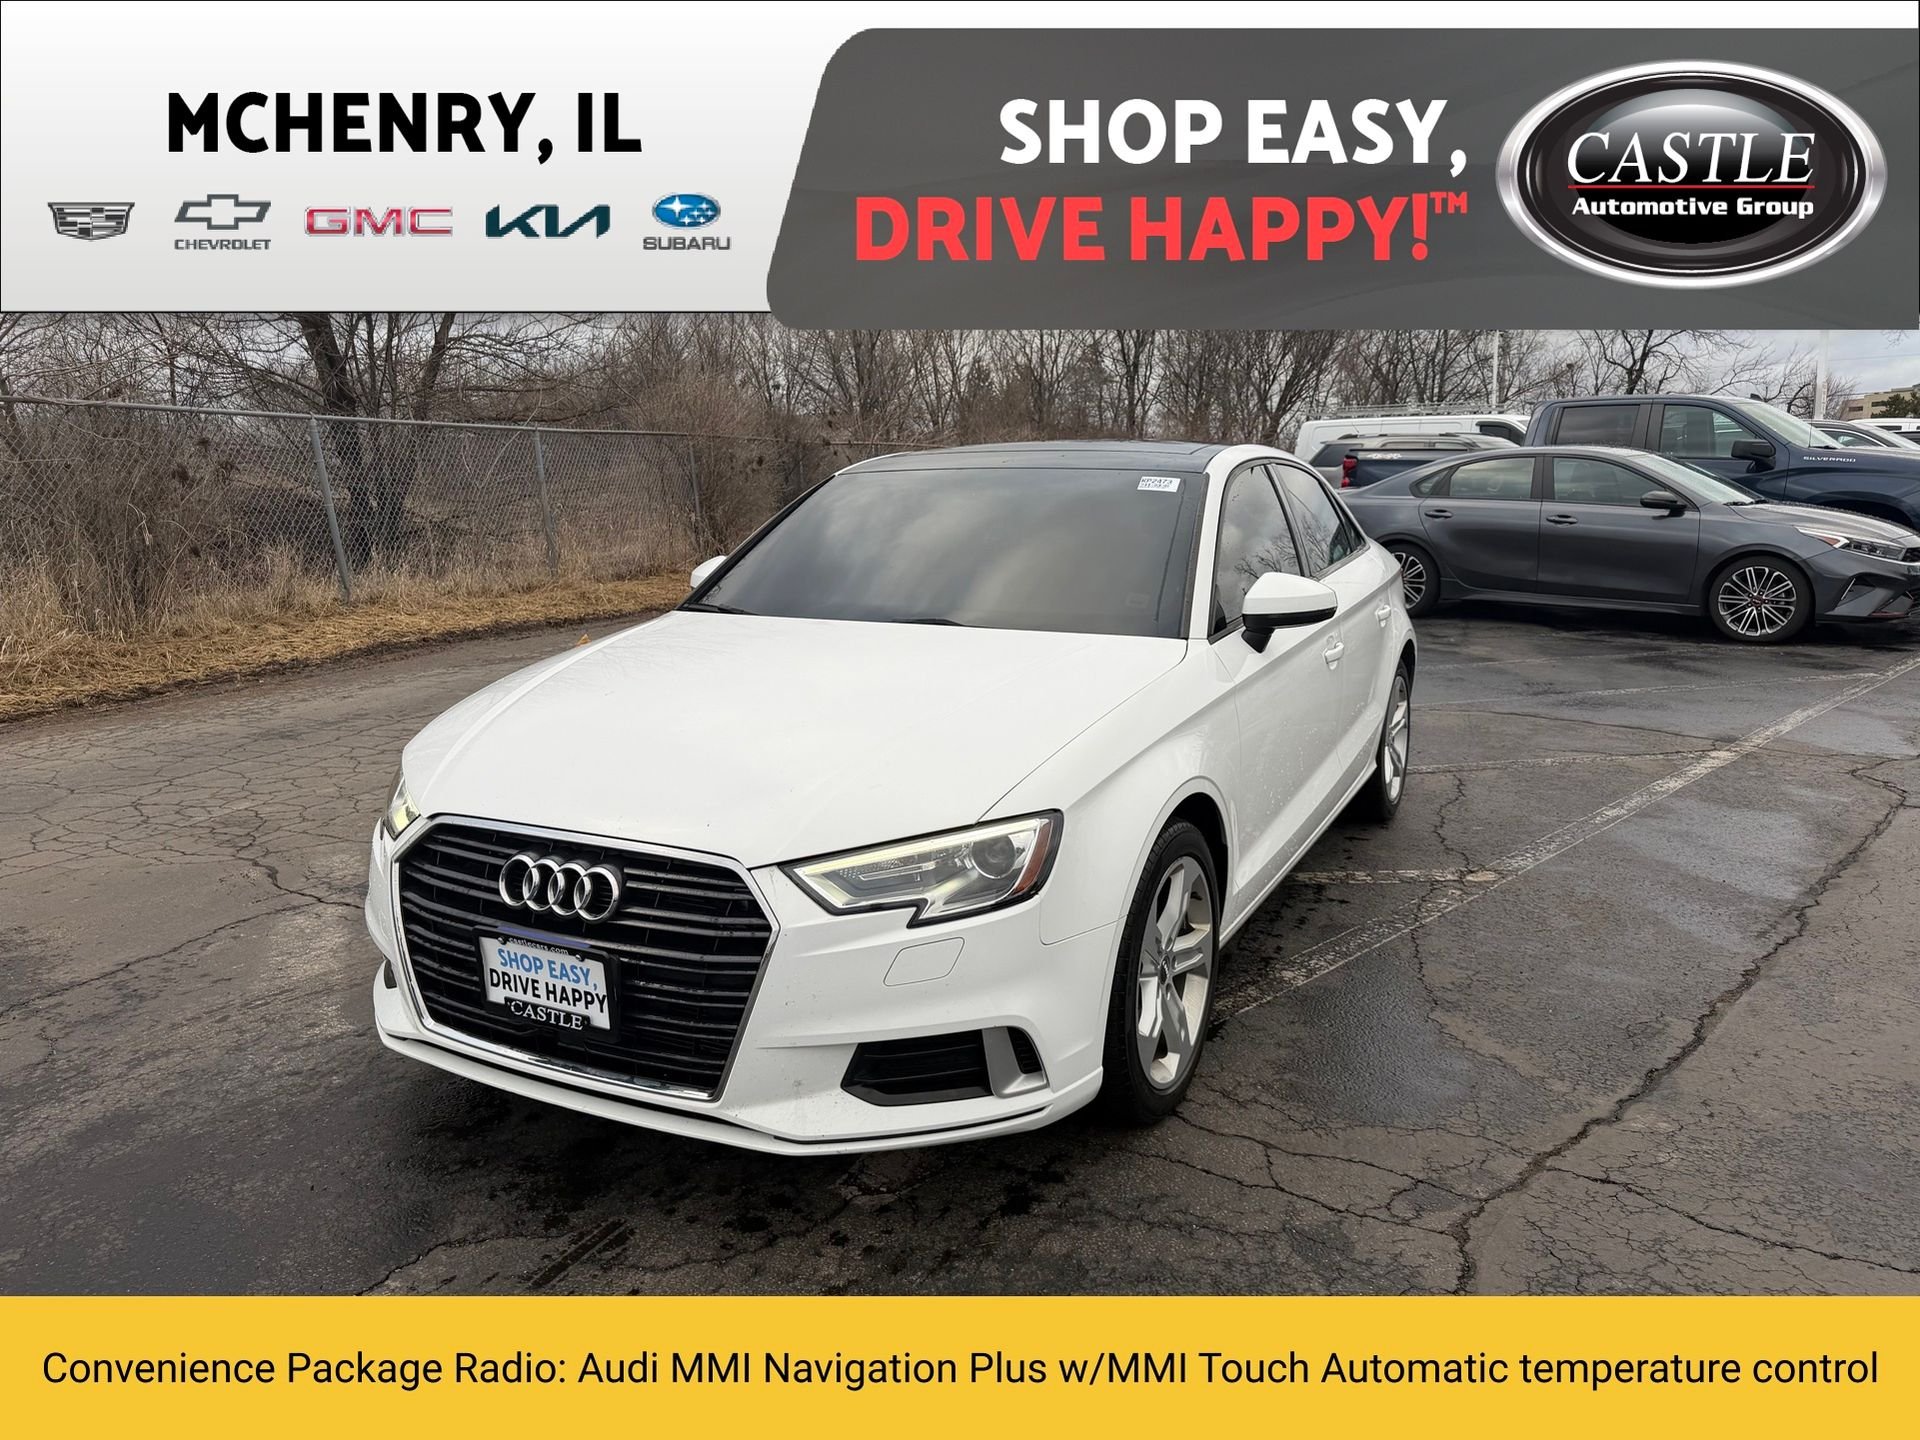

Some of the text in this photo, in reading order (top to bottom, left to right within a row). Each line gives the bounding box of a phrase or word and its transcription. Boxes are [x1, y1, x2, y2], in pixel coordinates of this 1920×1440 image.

[1803, 455, 1856, 463] SILVERADO
[497, 948, 598, 991] SHOP EASY,
[490, 969, 607, 1014] DRIVE HAPPY
[511, 1001, 583, 1030] CASTLE
